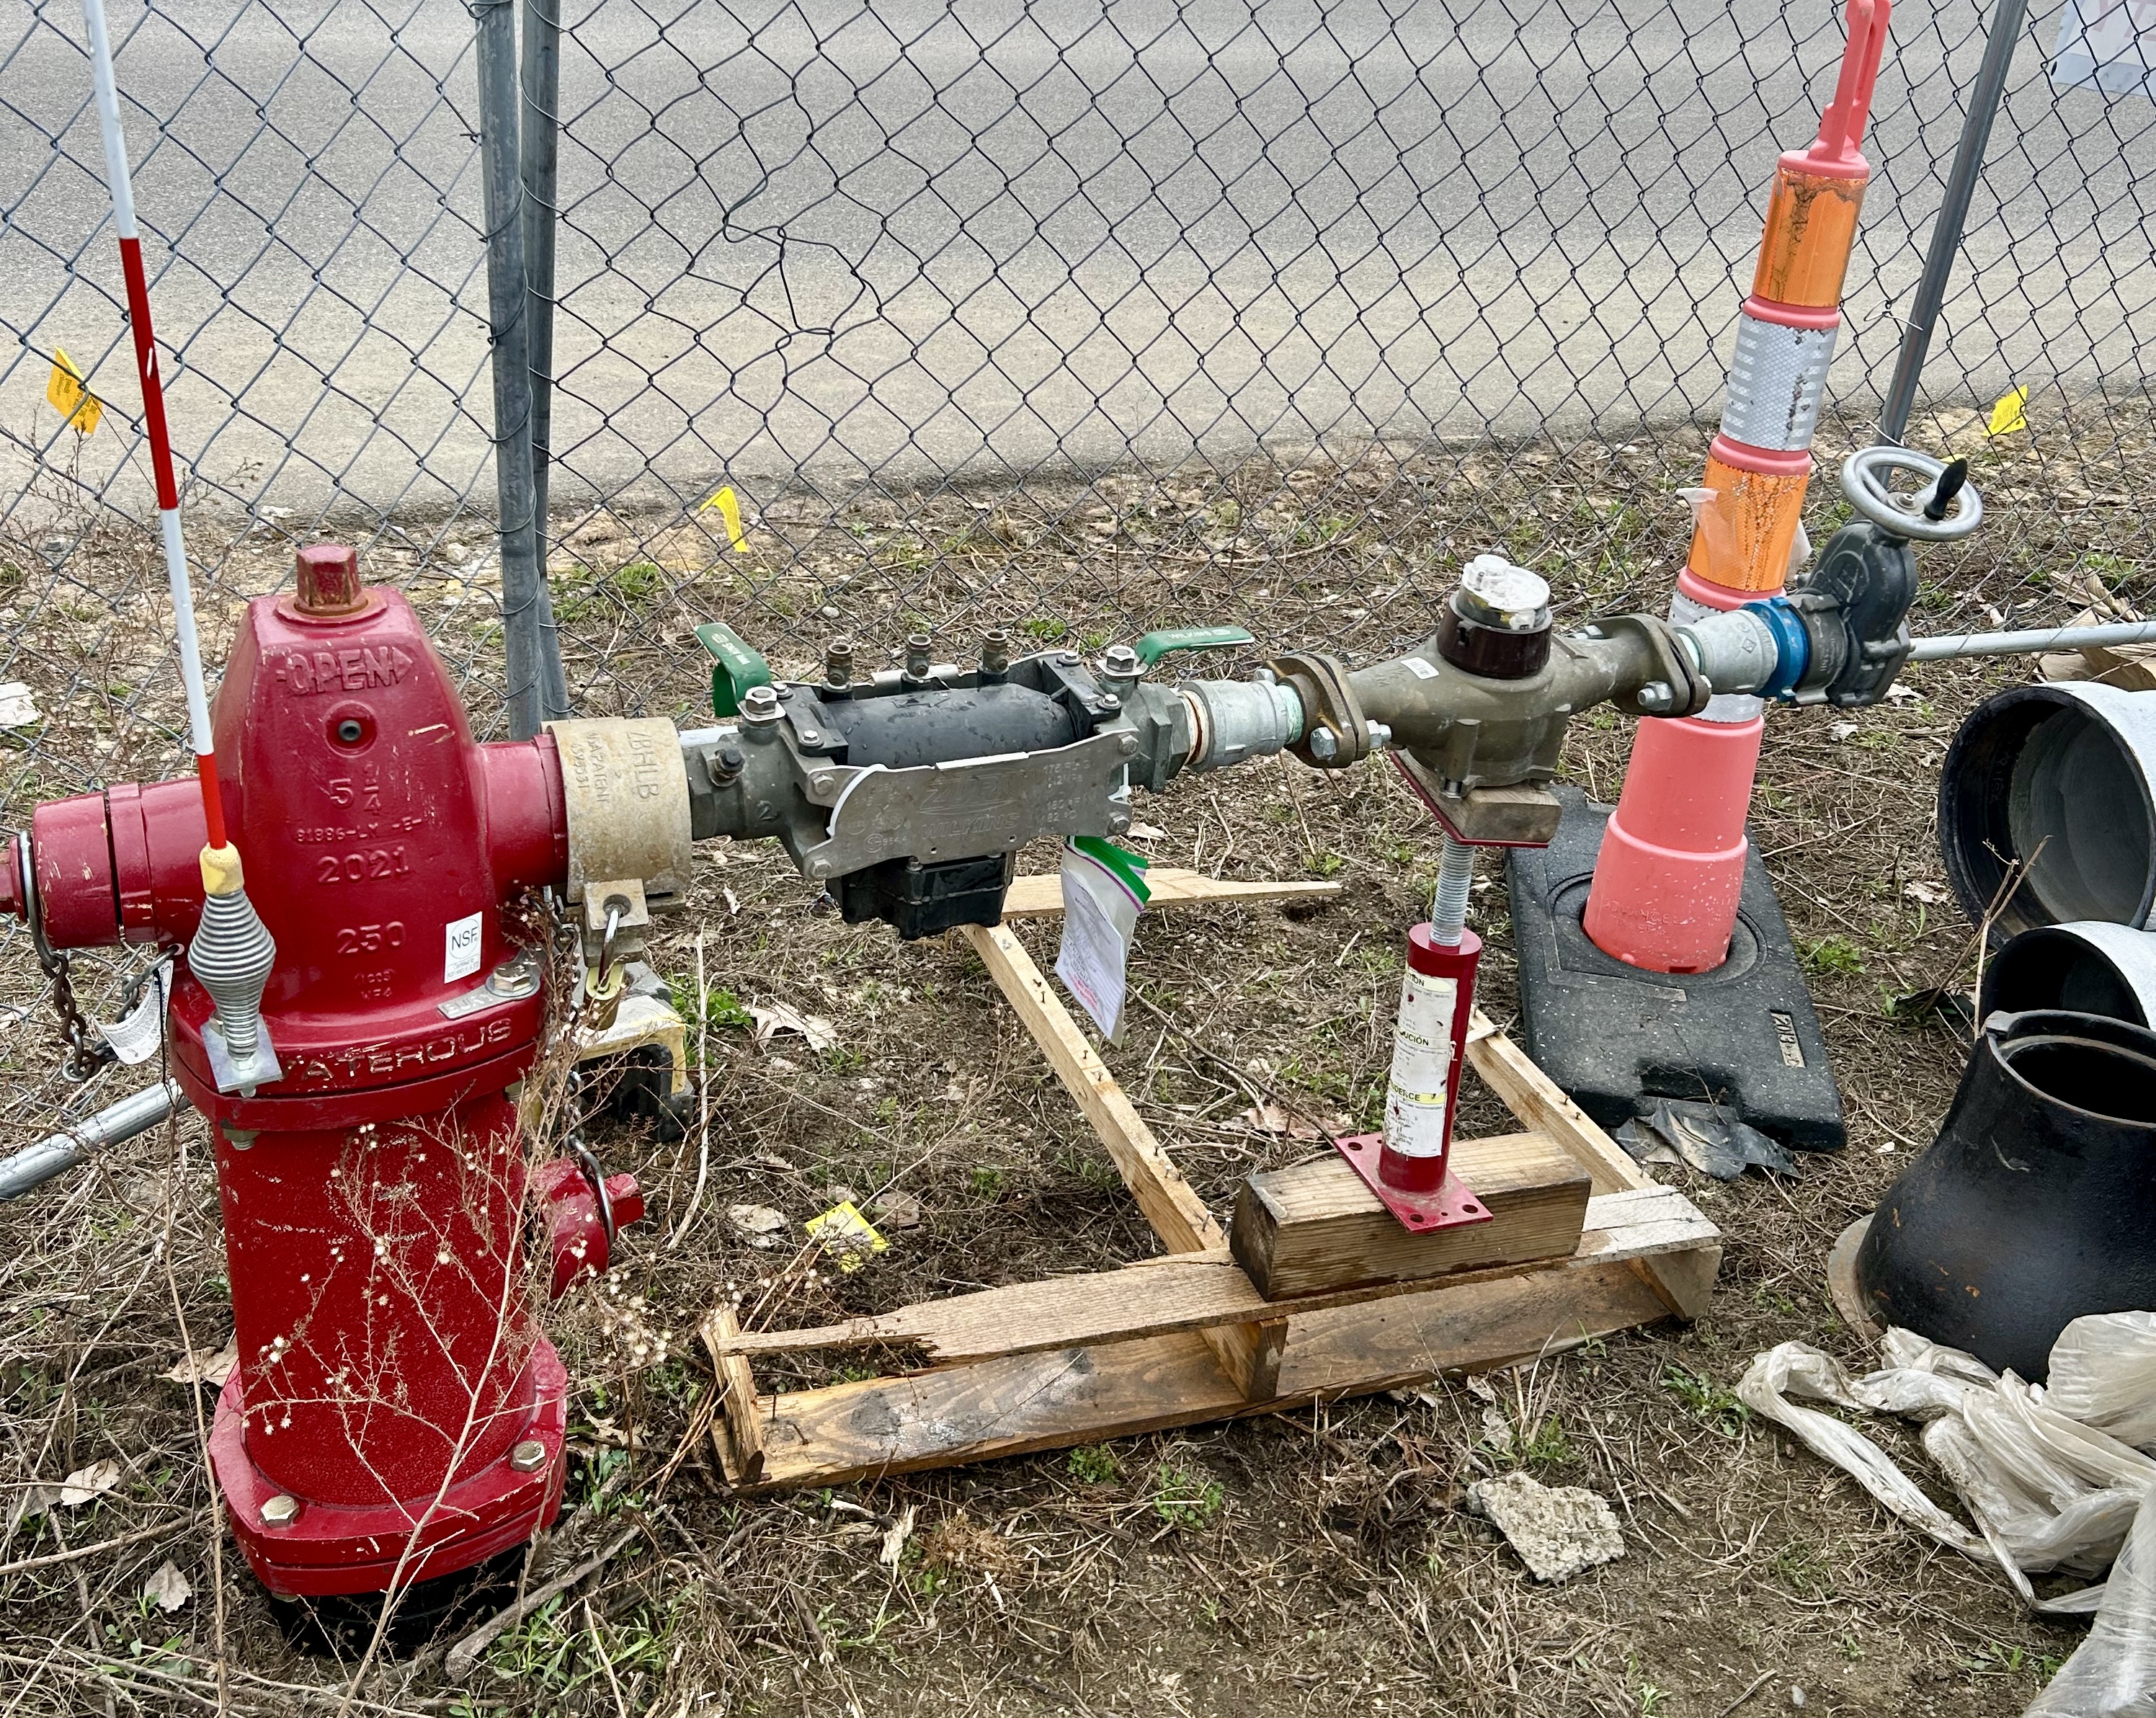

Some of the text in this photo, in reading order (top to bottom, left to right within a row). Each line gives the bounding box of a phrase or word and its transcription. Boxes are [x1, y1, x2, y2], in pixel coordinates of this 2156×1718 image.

[288, 646, 391, 696] OPEN
[328, 777, 355, 810] 5
[922, 811, 1021, 841] WILKINS
[317, 845, 411, 886] 2021
[337, 920, 407, 957] 250
[451, 926, 478, 951] NSF
